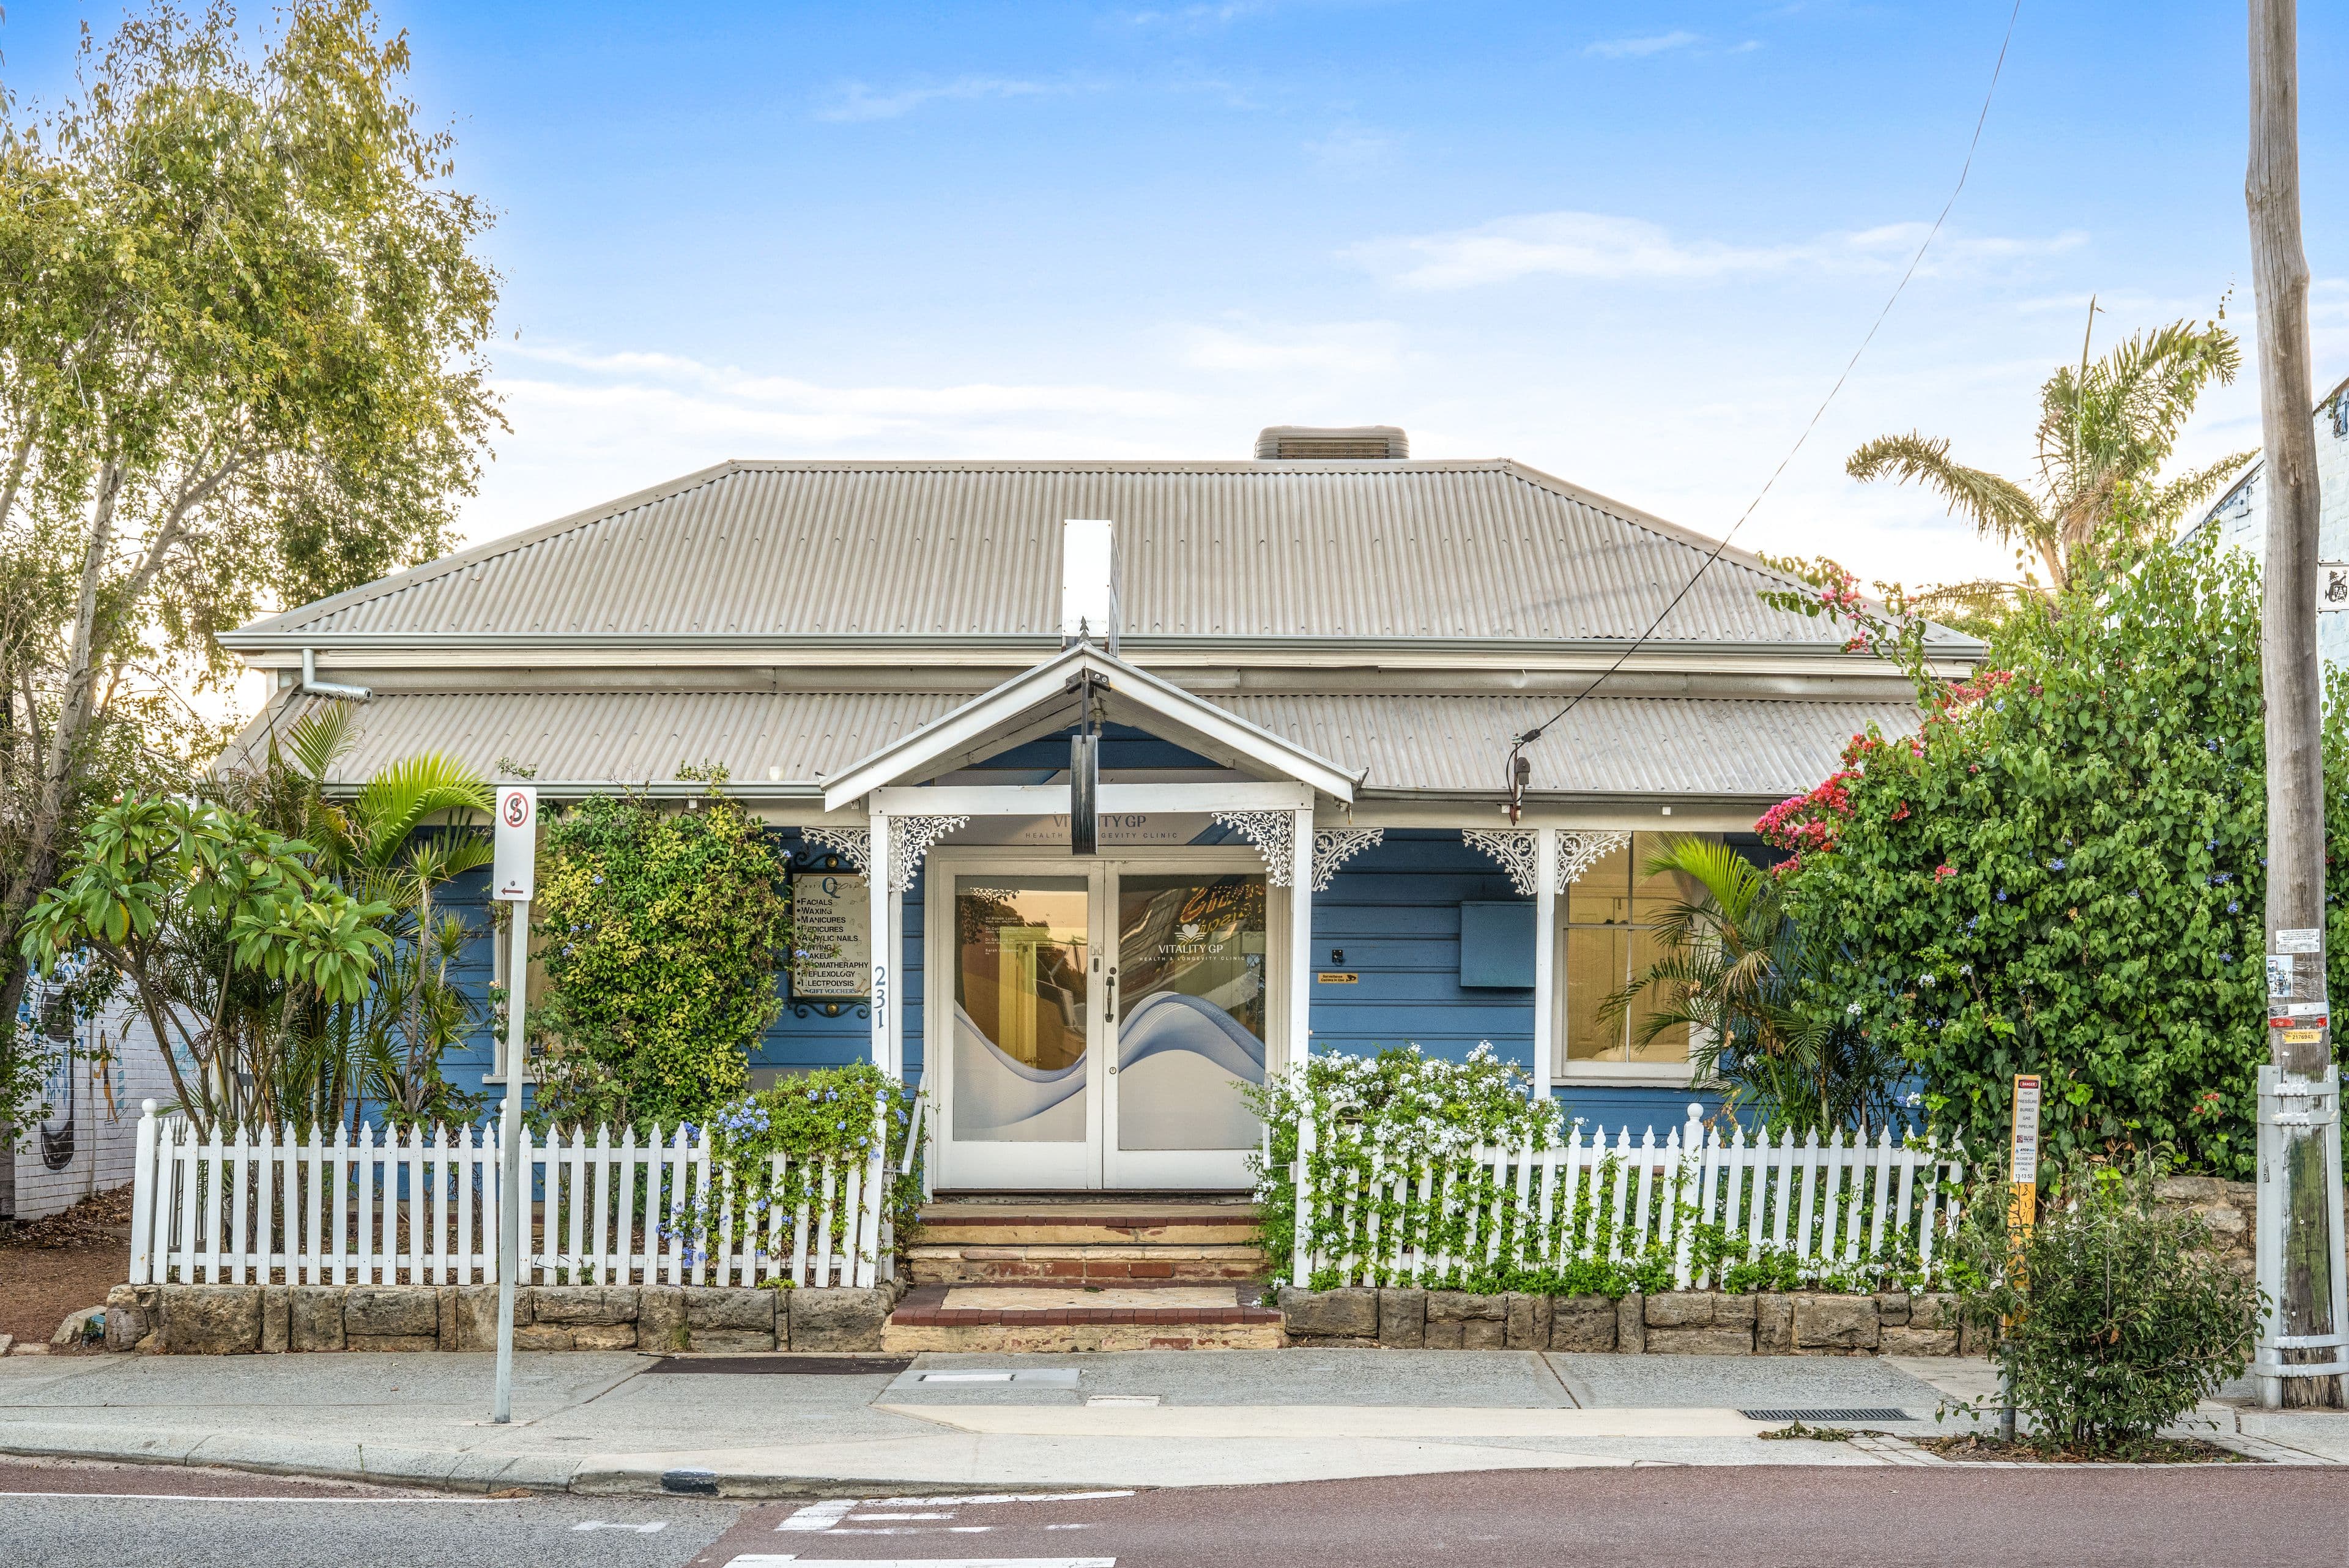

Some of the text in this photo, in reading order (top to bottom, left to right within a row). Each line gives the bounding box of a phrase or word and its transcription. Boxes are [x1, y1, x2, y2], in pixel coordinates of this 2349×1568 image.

[1052, 815, 1146, 828] VIITY GP
[822, 877, 841, 899] Q
[1159, 945, 1223, 954] VITALITY GP
